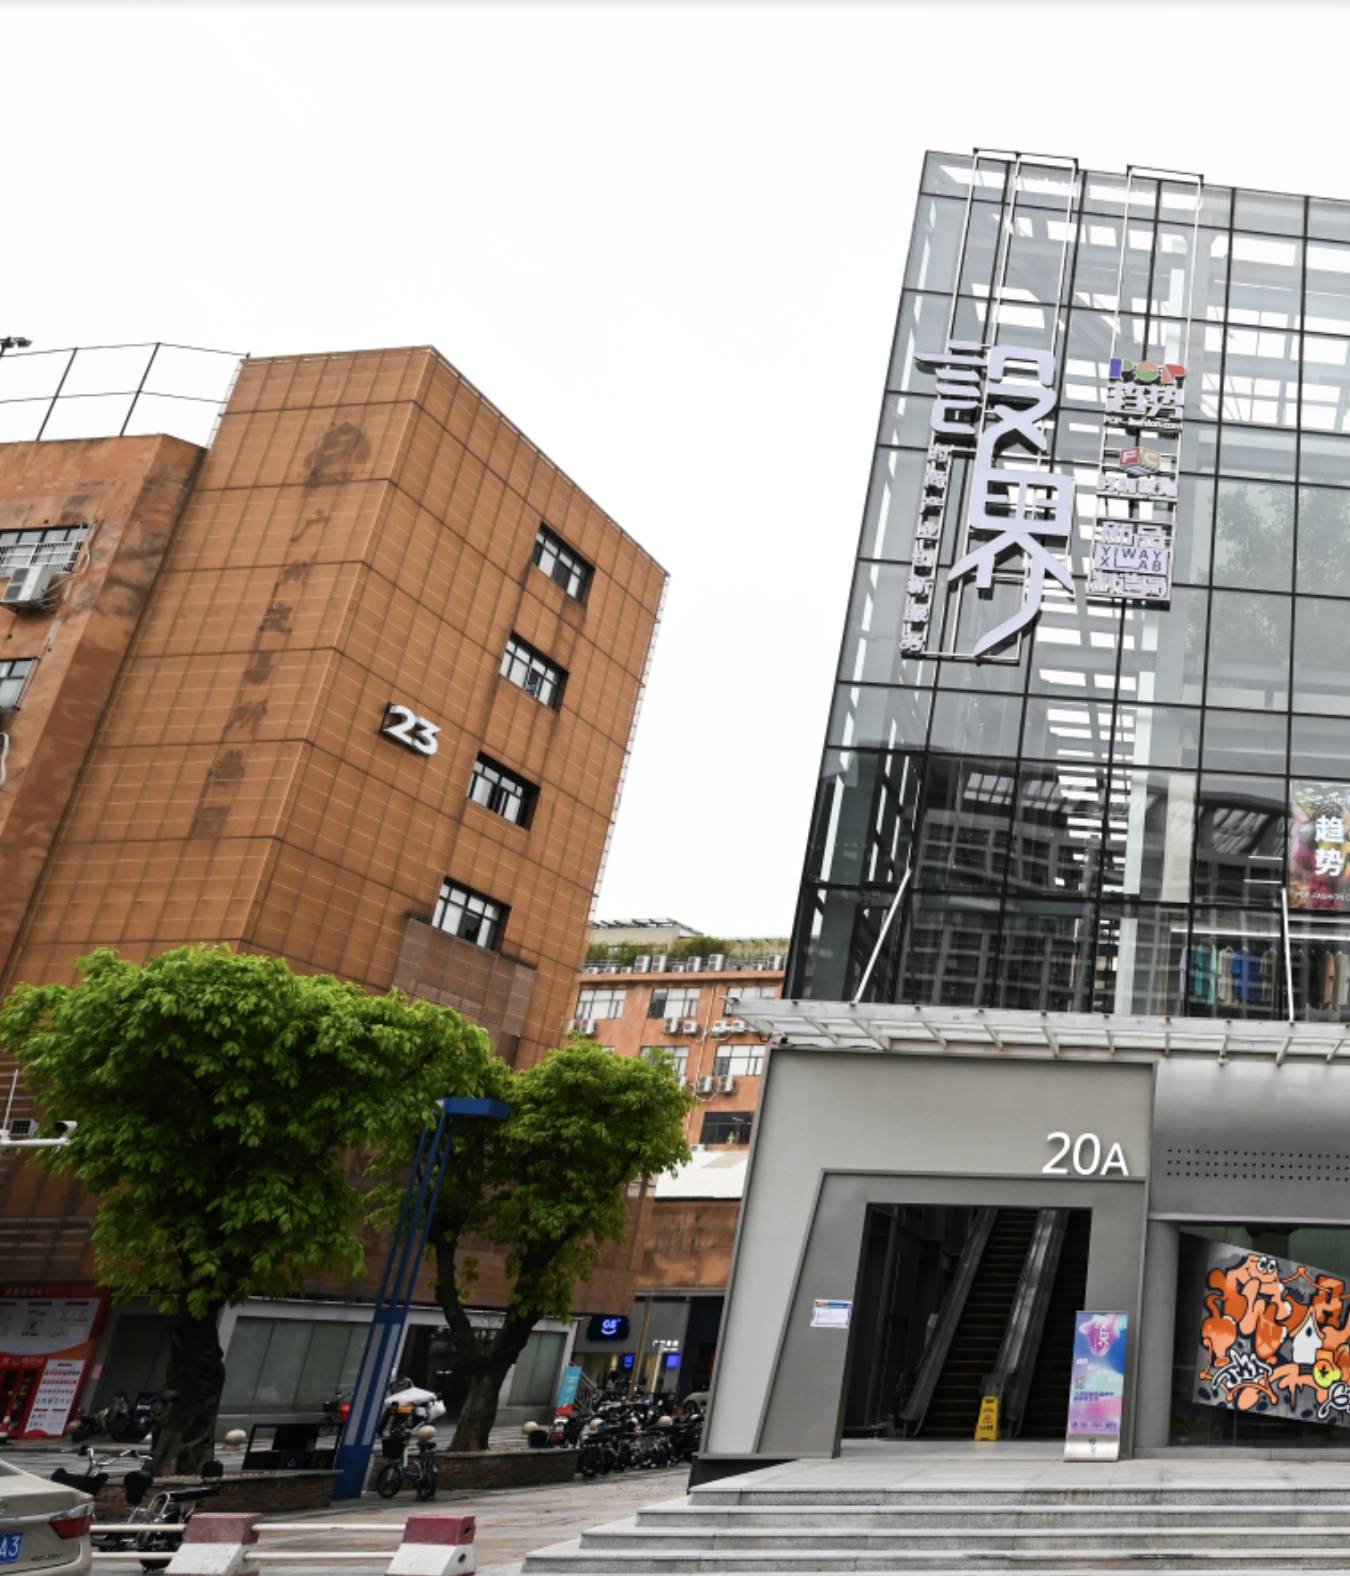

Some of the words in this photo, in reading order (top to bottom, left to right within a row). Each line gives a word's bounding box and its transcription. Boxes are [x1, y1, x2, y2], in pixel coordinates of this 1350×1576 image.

[383, 704, 442, 755] 23
[1315, 815, 1345, 877] 趋势
[1042, 1131, 1129, 1176] 20A
